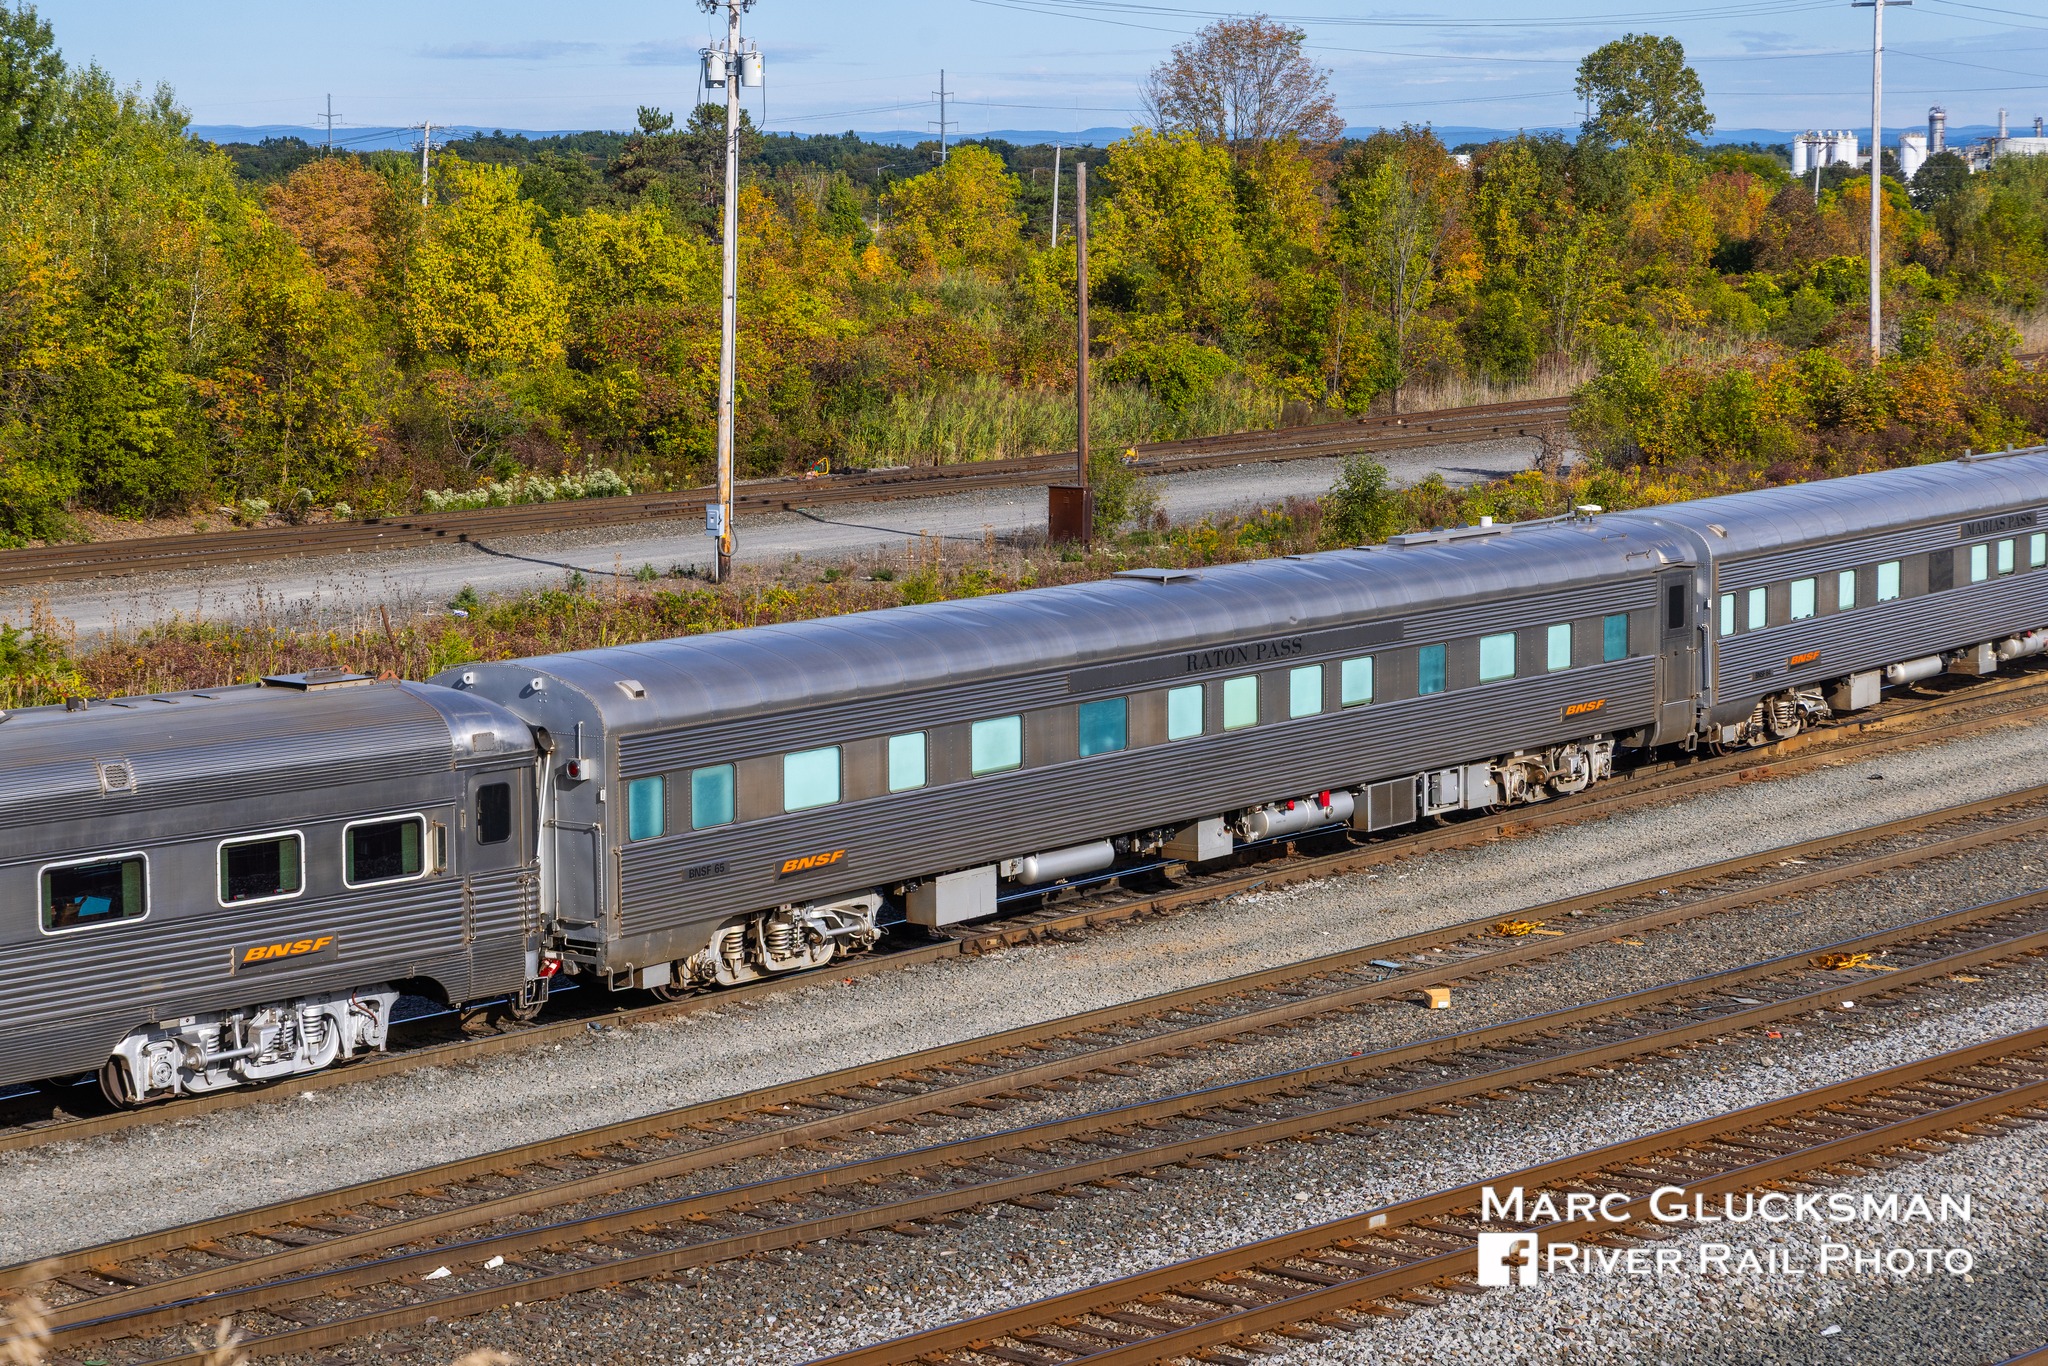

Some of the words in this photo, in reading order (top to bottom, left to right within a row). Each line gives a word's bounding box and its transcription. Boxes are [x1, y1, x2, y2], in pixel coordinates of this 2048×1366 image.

[1967, 518, 2006, 535] MARIAS
[2008, 512, 2032, 528] PASS
[1186, 645, 1248, 671] RATON
[1256, 638, 1302, 660] PASS
[1790, 649, 1821, 665] BNSF
[1565, 699, 1606, 716] BNSF
[688, 865, 712, 879] BNSF
[714, 862, 725, 873] 65
[781, 849, 845, 873] BNSF
[243, 936, 334, 962] BNSF
